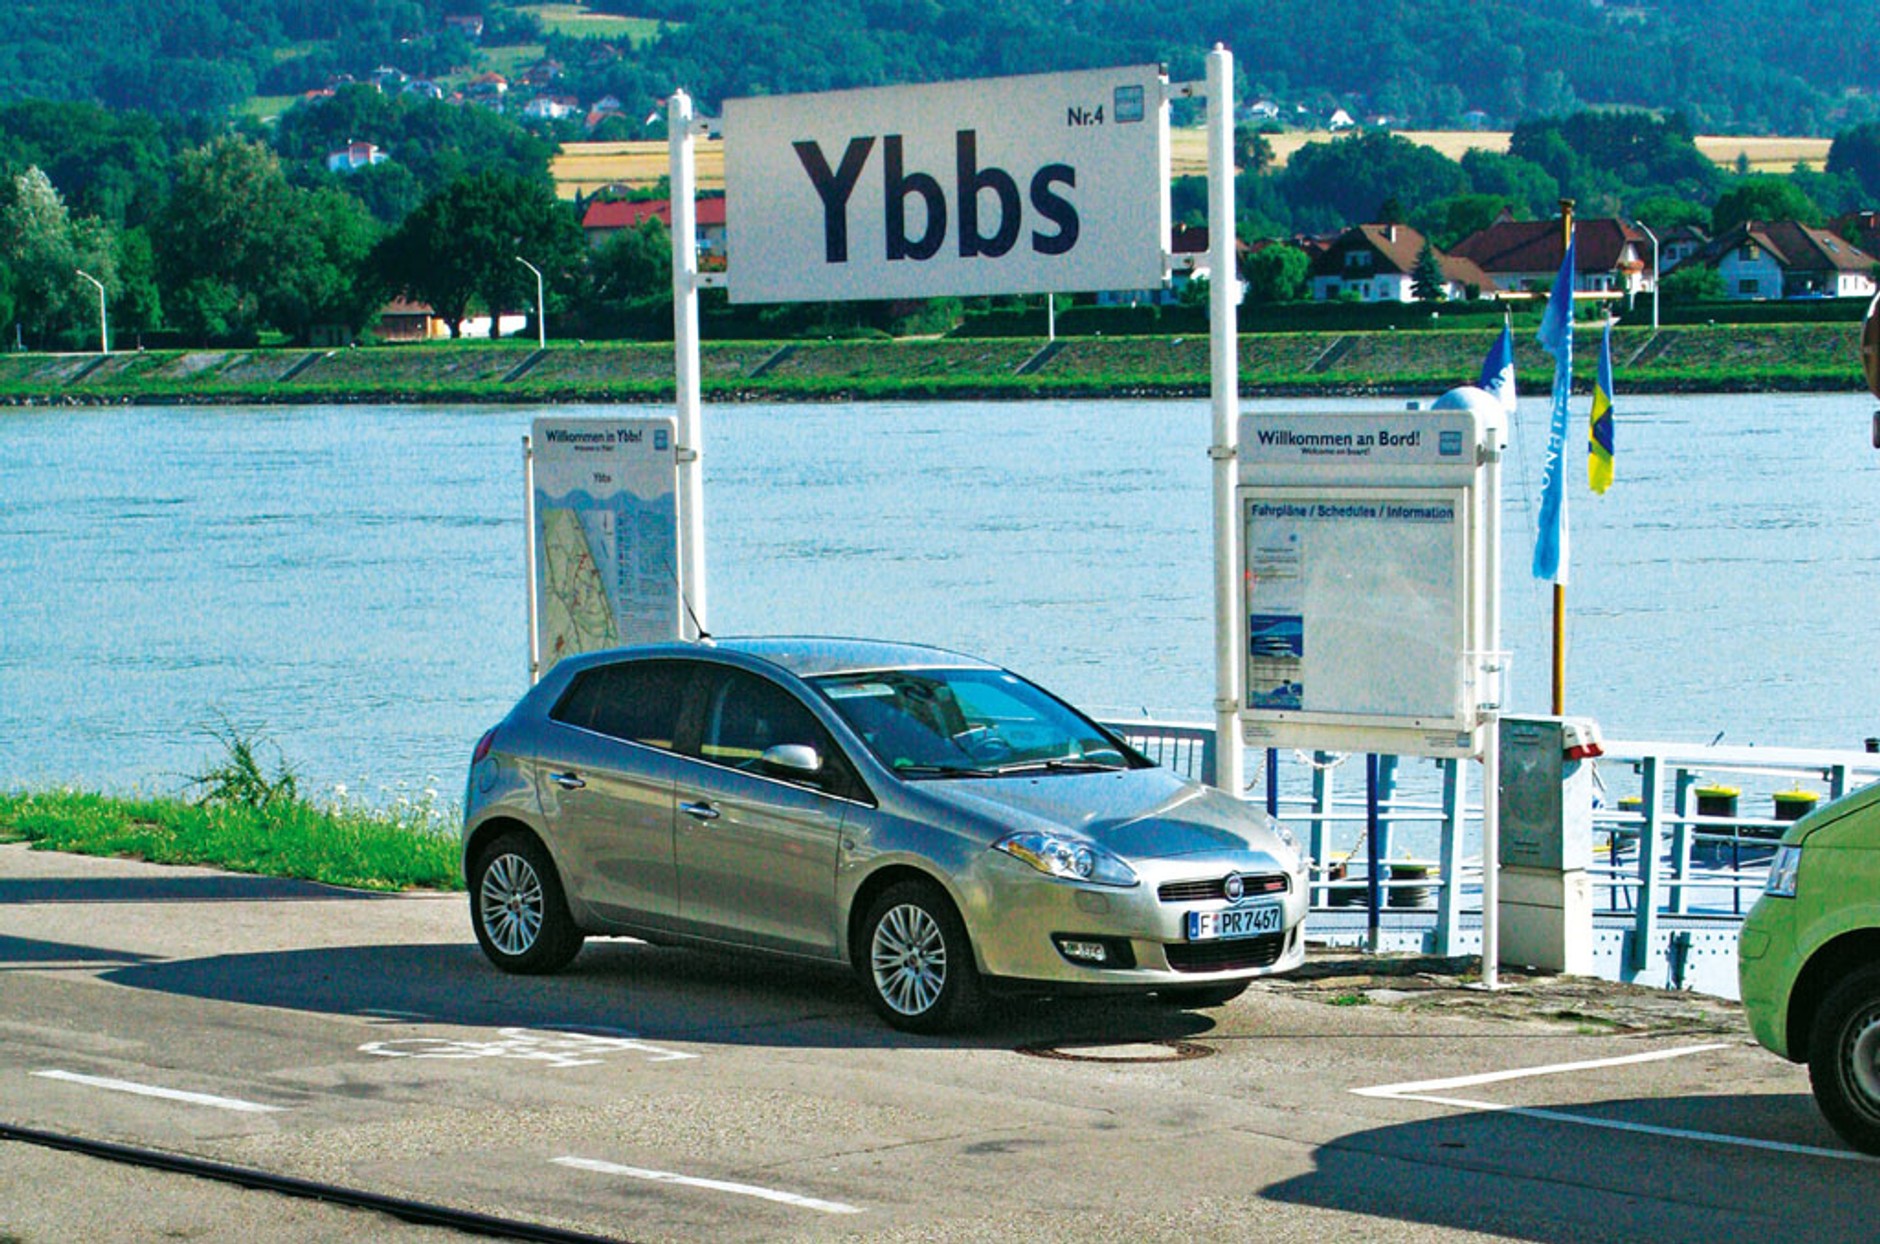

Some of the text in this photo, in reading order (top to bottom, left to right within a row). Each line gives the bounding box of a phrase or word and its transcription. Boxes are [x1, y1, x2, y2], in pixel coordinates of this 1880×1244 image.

[1067, 104, 1104, 127] Nr.4
[791, 129, 1080, 264] Ybbs
[545, 429, 643, 443] Willkommen in Ybbs!
[1257, 430, 1421, 447] Willkommen an Bord!
[1251, 504, 1307, 519] Fahrpläne
[1317, 504, 1376, 518] Schedules
[1387, 504, 1455, 519] Information
[1200, 915, 1211, 934] F
